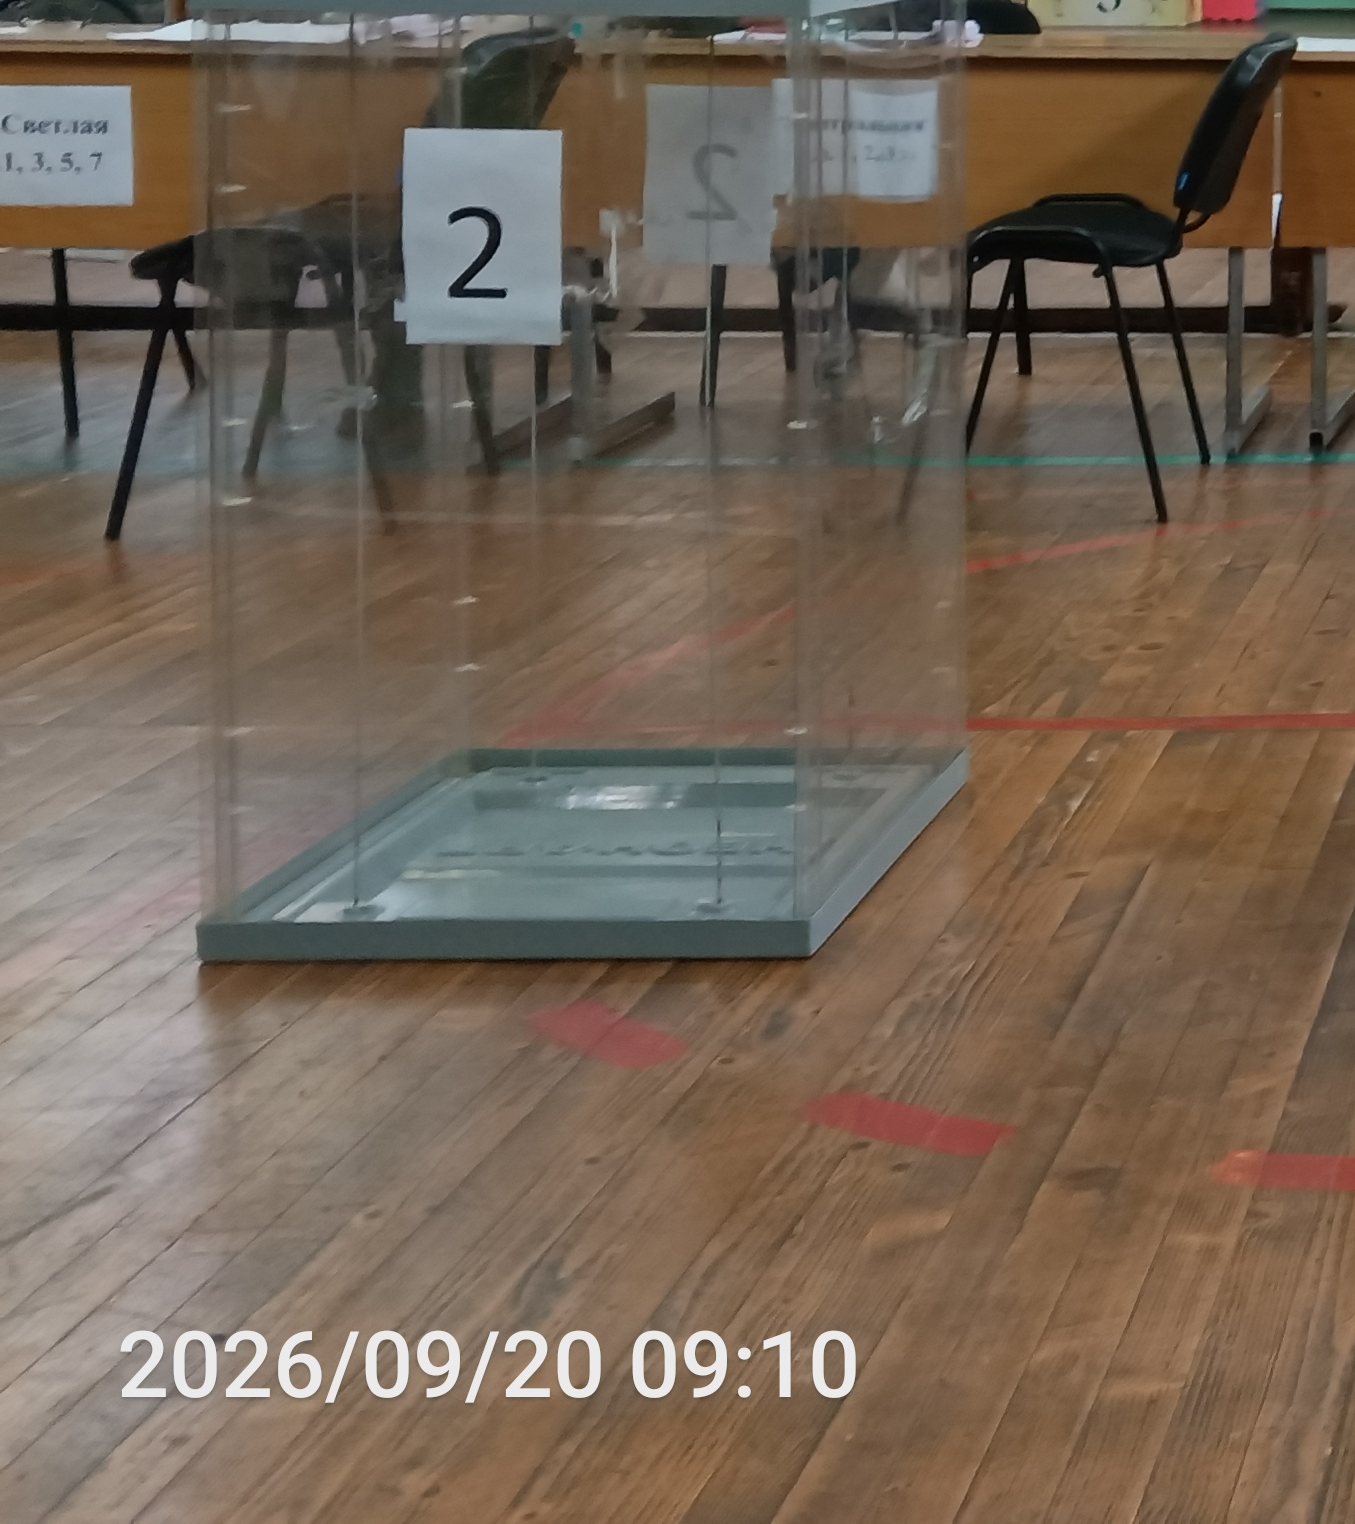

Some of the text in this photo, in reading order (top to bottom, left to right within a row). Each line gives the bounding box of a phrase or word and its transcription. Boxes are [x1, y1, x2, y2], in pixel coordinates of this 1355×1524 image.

[1, 113, 109, 135] Светлая
[89, 151, 103, 172] 7
[447, 206, 508, 298] 2
